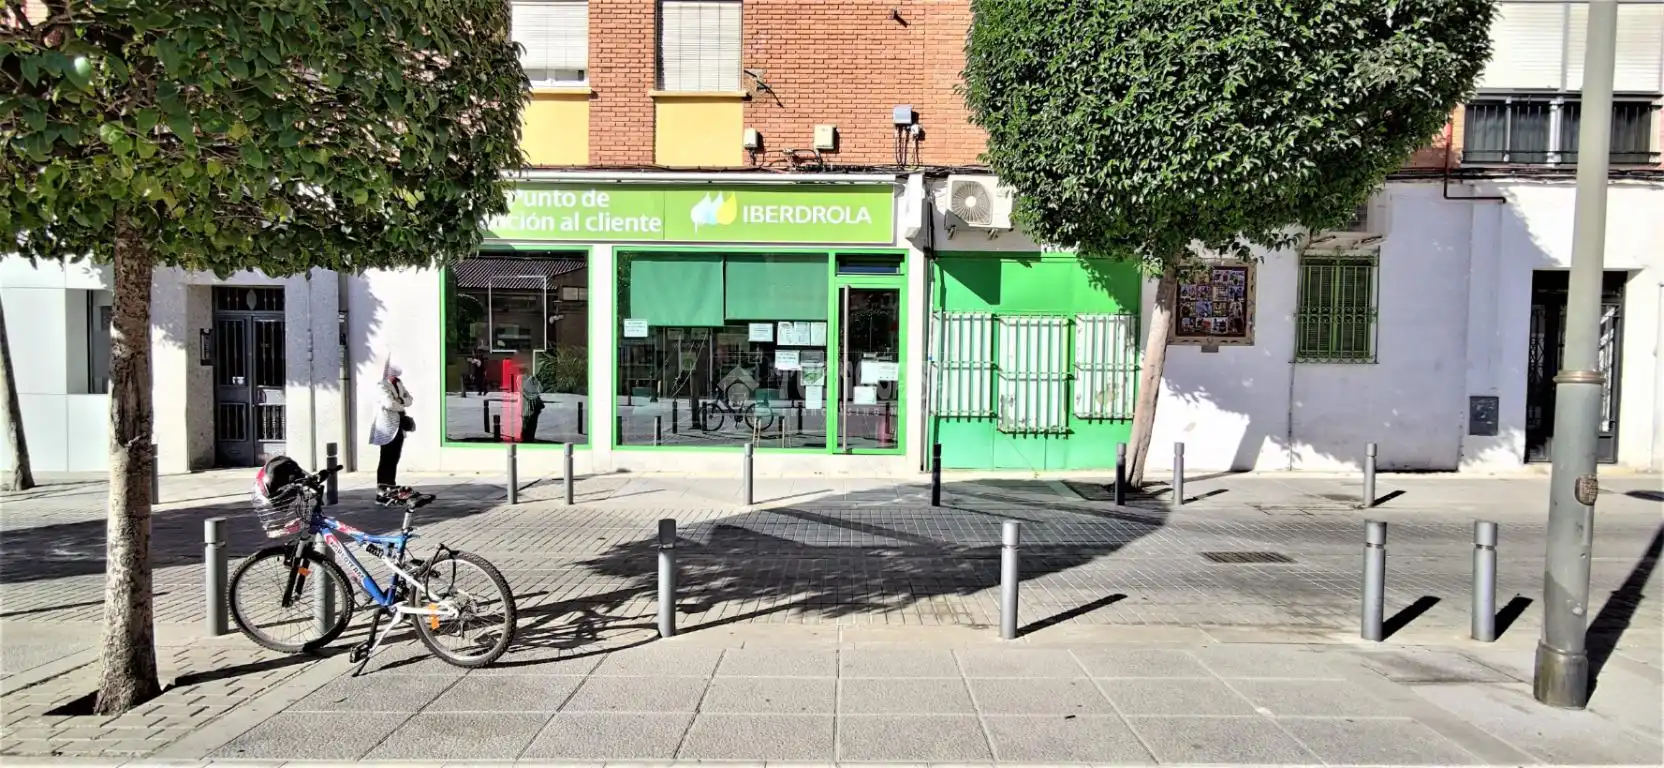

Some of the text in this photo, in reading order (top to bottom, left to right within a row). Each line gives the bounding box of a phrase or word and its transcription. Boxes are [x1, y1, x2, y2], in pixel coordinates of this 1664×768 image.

[581, 190, 610, 208] de
[560, 211, 579, 231] al
[585, 211, 662, 232] cliente
[742, 205, 872, 224] IBERDROLA
